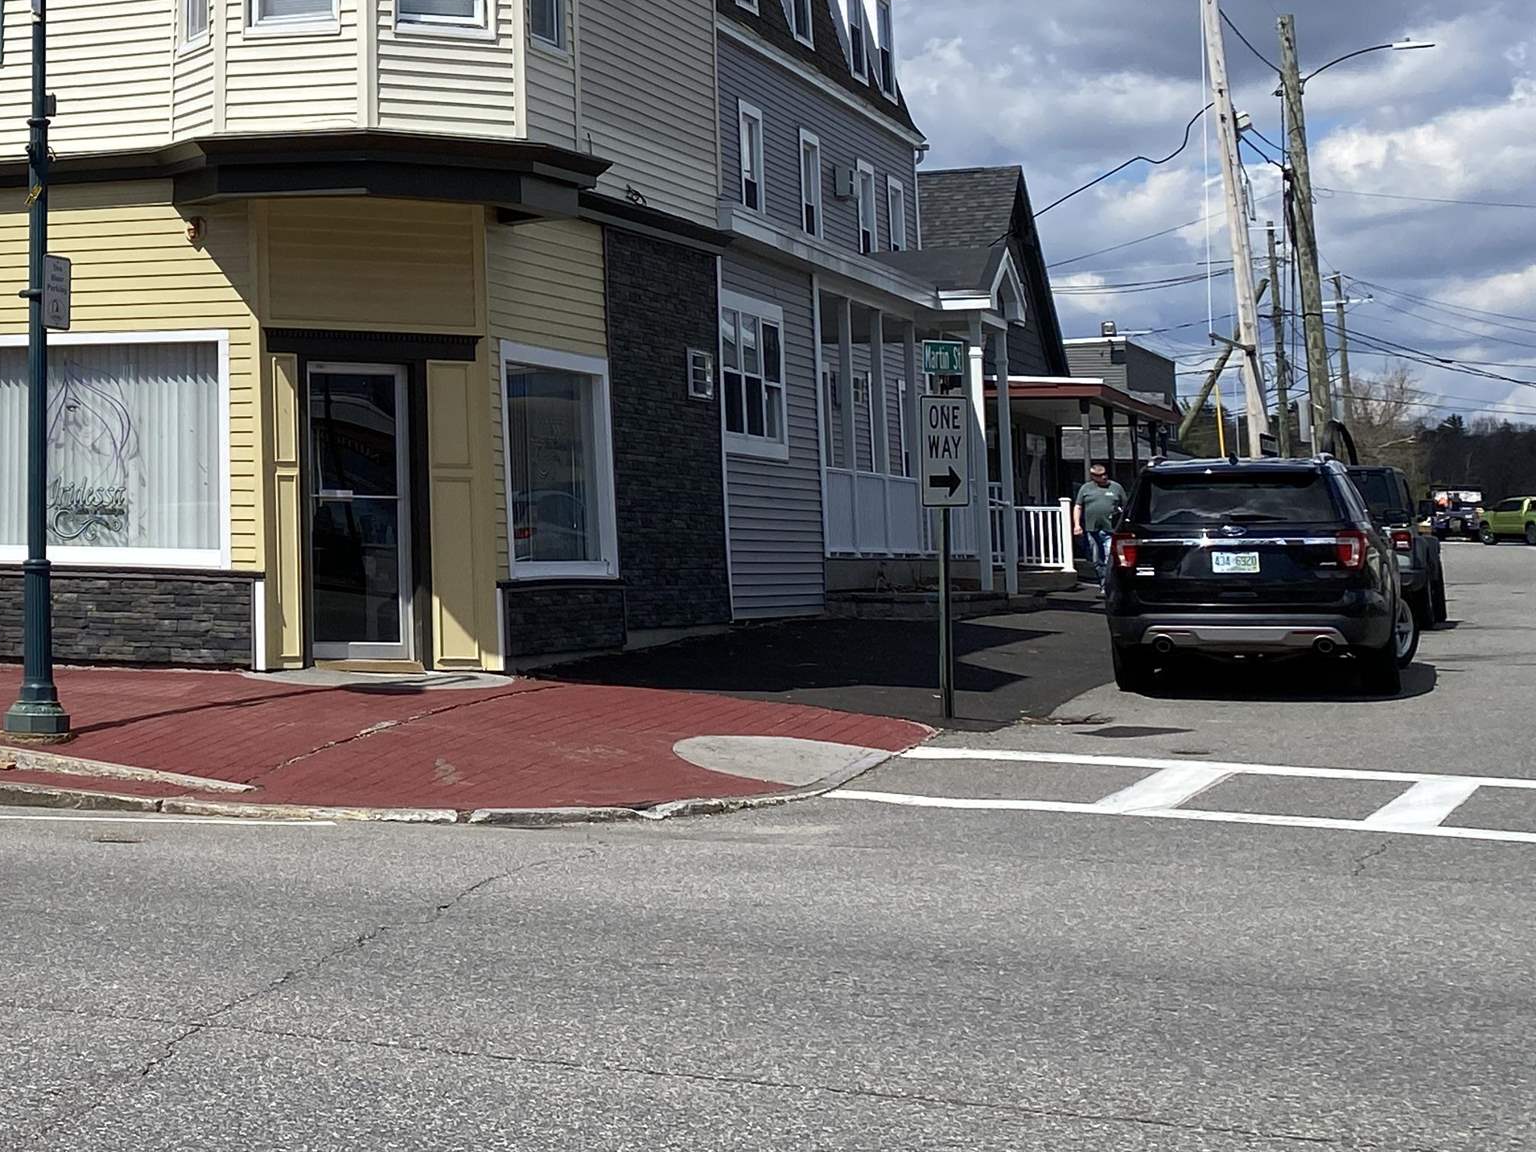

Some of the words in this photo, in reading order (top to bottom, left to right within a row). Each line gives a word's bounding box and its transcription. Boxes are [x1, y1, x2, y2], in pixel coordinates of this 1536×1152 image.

[925, 344, 949, 369] Martin
[953, 346, 962, 370] St
[929, 405, 961, 429] ONE
[928, 436, 962, 459] WAY
